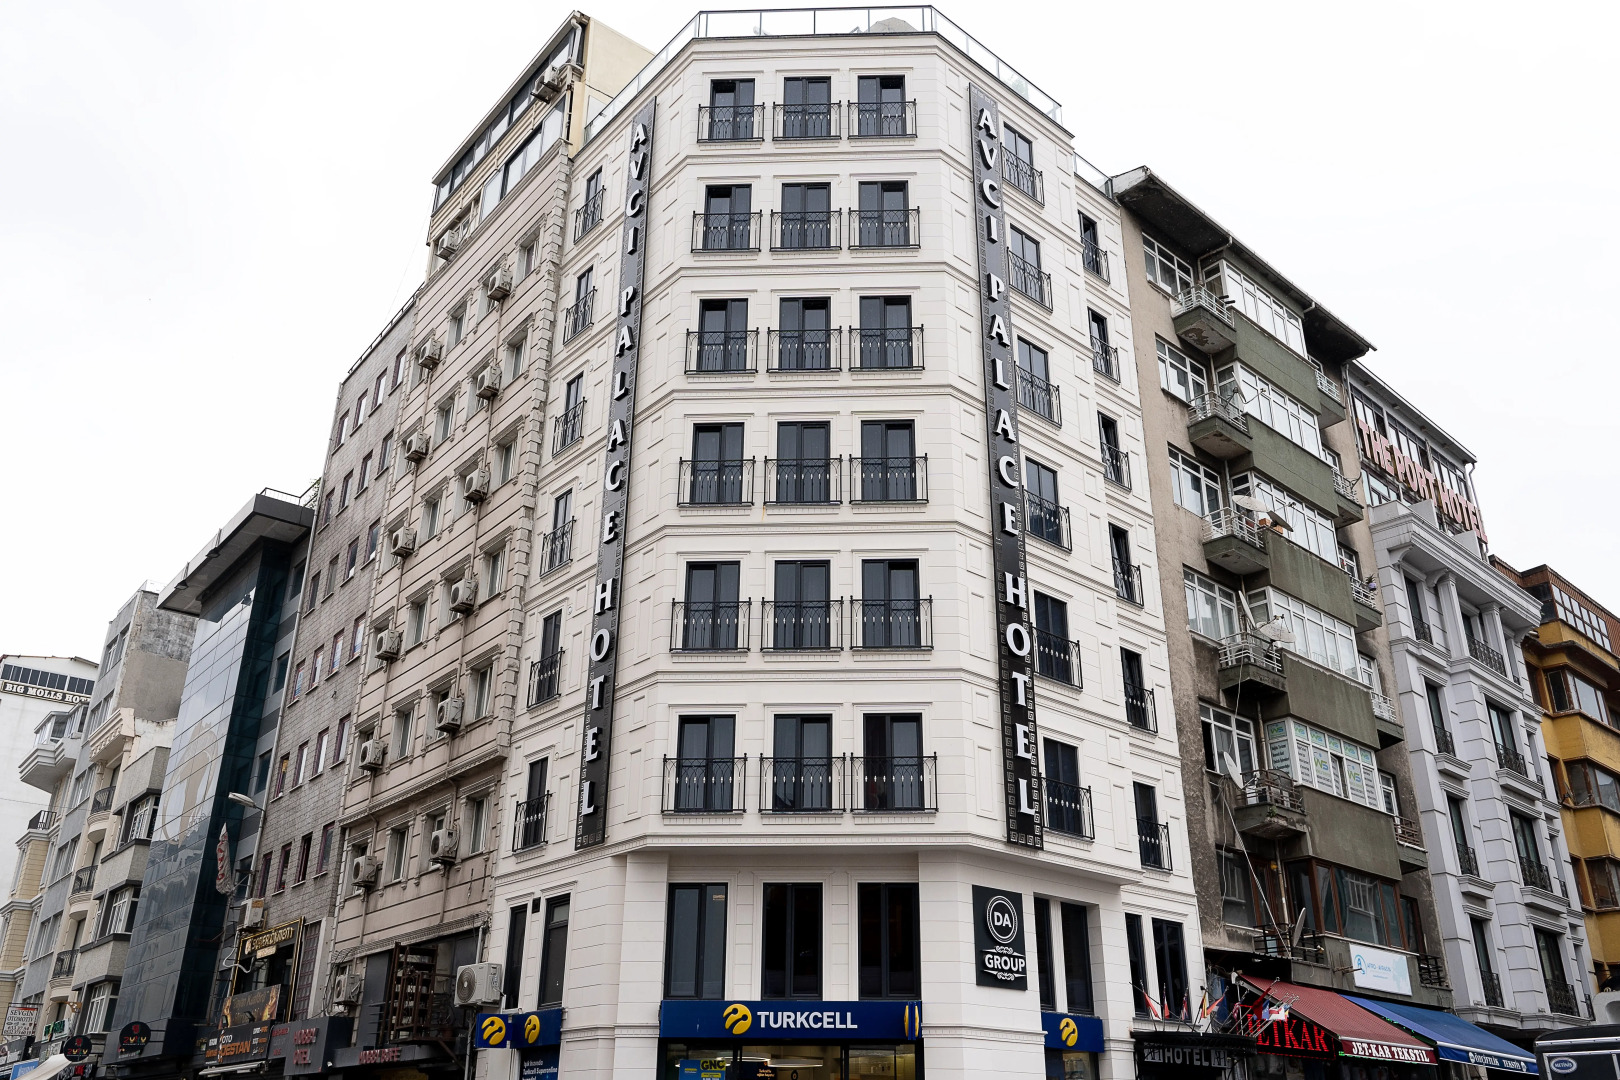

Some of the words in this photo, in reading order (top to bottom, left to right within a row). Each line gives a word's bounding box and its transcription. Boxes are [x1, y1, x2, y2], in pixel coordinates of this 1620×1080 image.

[625, 122, 647, 255] AVCI
[978, 107, 1000, 243] AVCI
[603, 286, 636, 544] PALACE
[987, 272, 1019, 537] PALACE
[1359, 420, 1395, 477] THE
[1393, 446, 1439, 508] PORT
[1438, 479, 1488, 545] HOTEL
[5, 683, 25, 693] BIG
[27, 687, 63, 700] MOLLS
[580, 581, 613, 816] HOTEL
[1004, 572, 1036, 817] HOTEL
[985, 954, 1026, 972] GROUP
[994, 911, 1012, 928] DA
[701, 1060, 726, 1070] GNC
[757, 1011, 858, 1029] TURKCELL
[1165, 1048, 1209, 1066] HOTEL
